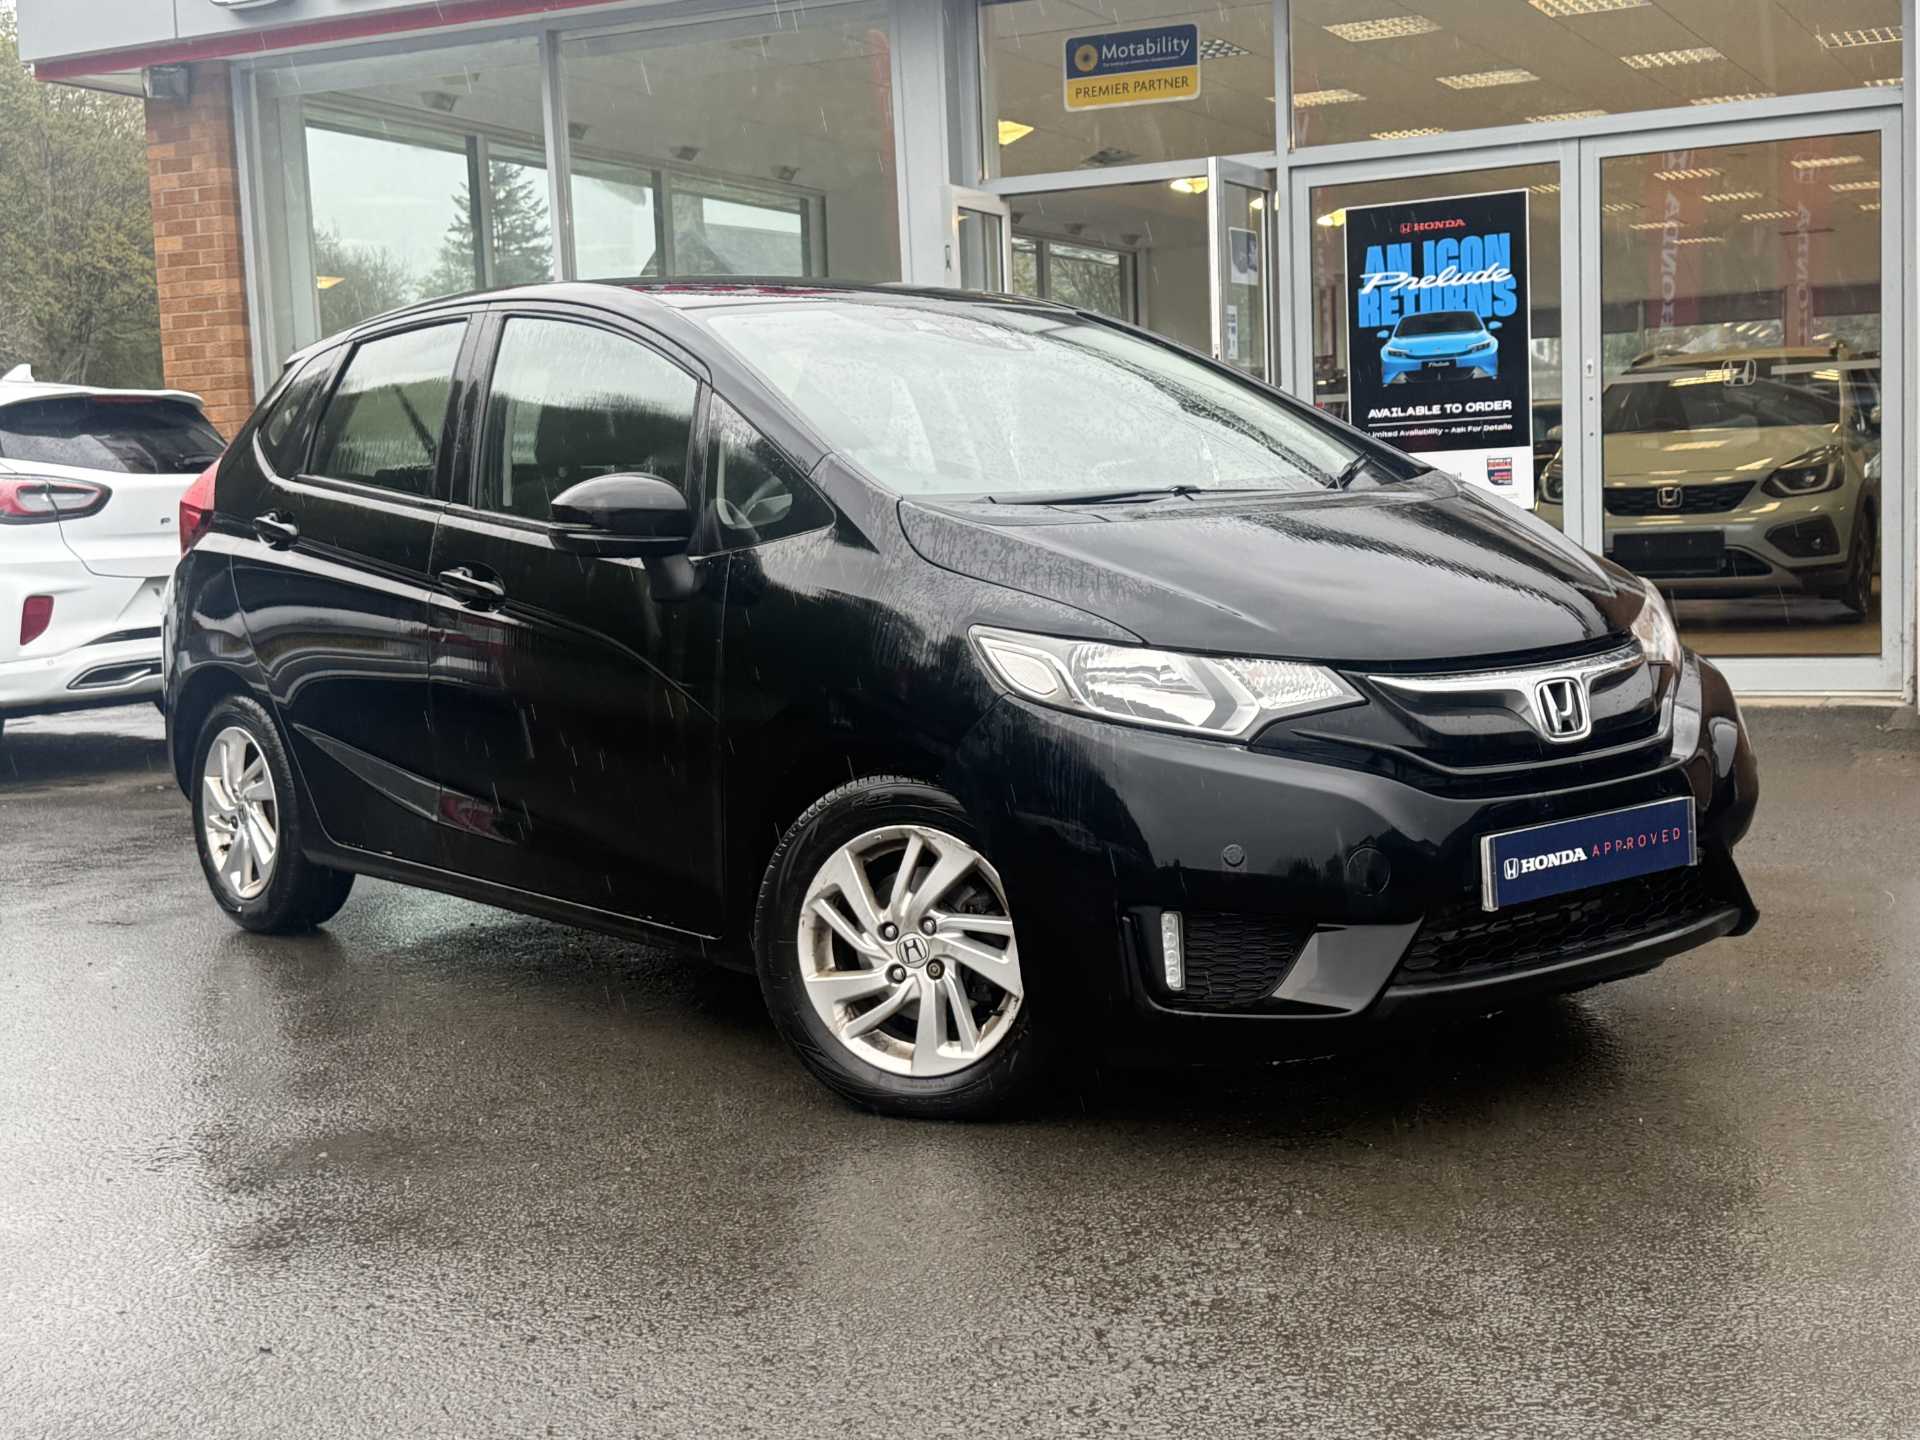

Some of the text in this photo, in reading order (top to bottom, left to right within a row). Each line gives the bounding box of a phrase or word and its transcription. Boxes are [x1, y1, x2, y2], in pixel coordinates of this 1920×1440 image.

[1101, 36, 1190, 60] Motability
[1075, 76, 1189, 98] PREMIER PARTNER
[1413, 218, 1467, 231] HONDA
[1363, 232, 1511, 286] AN ICON
[1360, 262, 1513, 294] Prelude
[1358, 276, 1518, 328] RETURNS
[1367, 399, 1513, 419] AVAILABLE TO ORDER
[1451, 425, 1466, 434] Ask
[1520, 847, 1588, 873] HONDA
[1592, 827, 1681, 857] APPROVED
